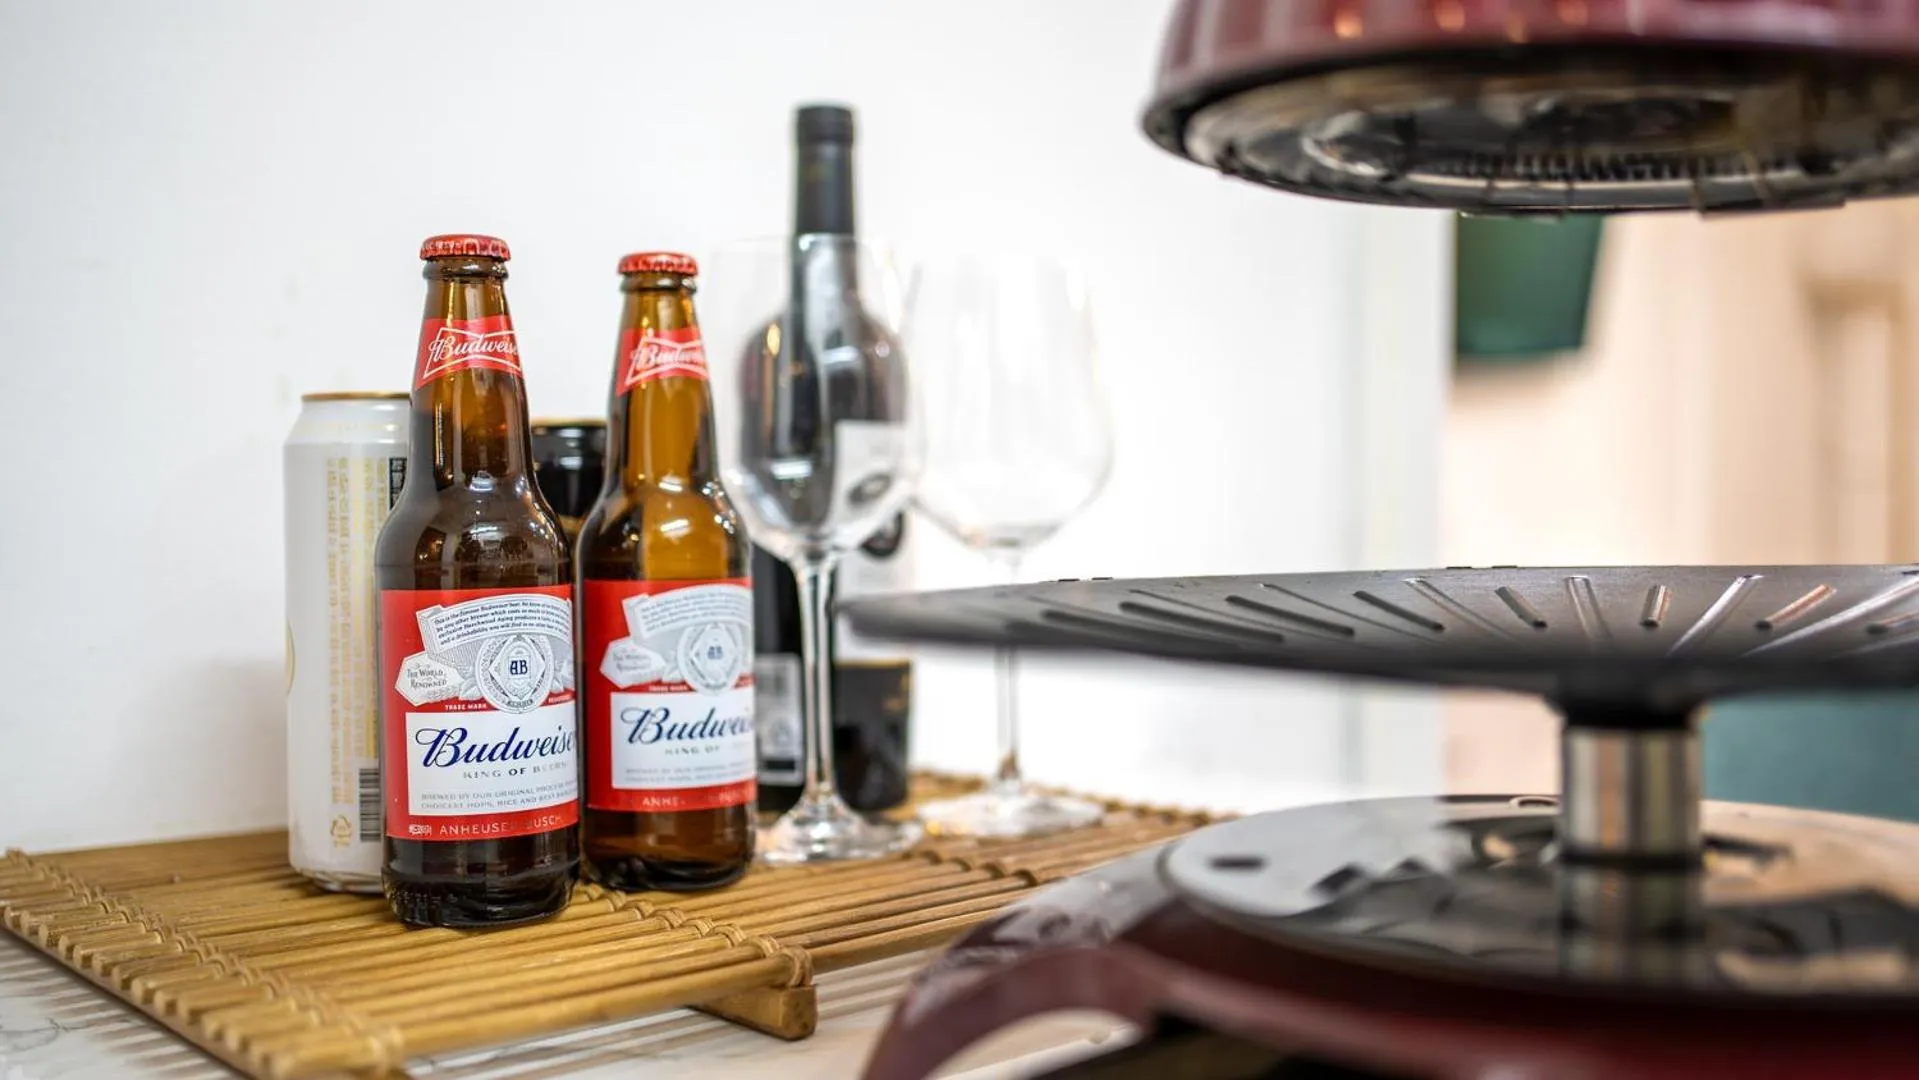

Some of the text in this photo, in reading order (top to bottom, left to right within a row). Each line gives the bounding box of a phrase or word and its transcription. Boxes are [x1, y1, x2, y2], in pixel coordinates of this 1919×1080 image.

[510, 659, 528, 675] AB
[415, 725, 575, 768] Budweise
[463, 769, 501, 779] KING
[508, 767, 527, 777] OF
